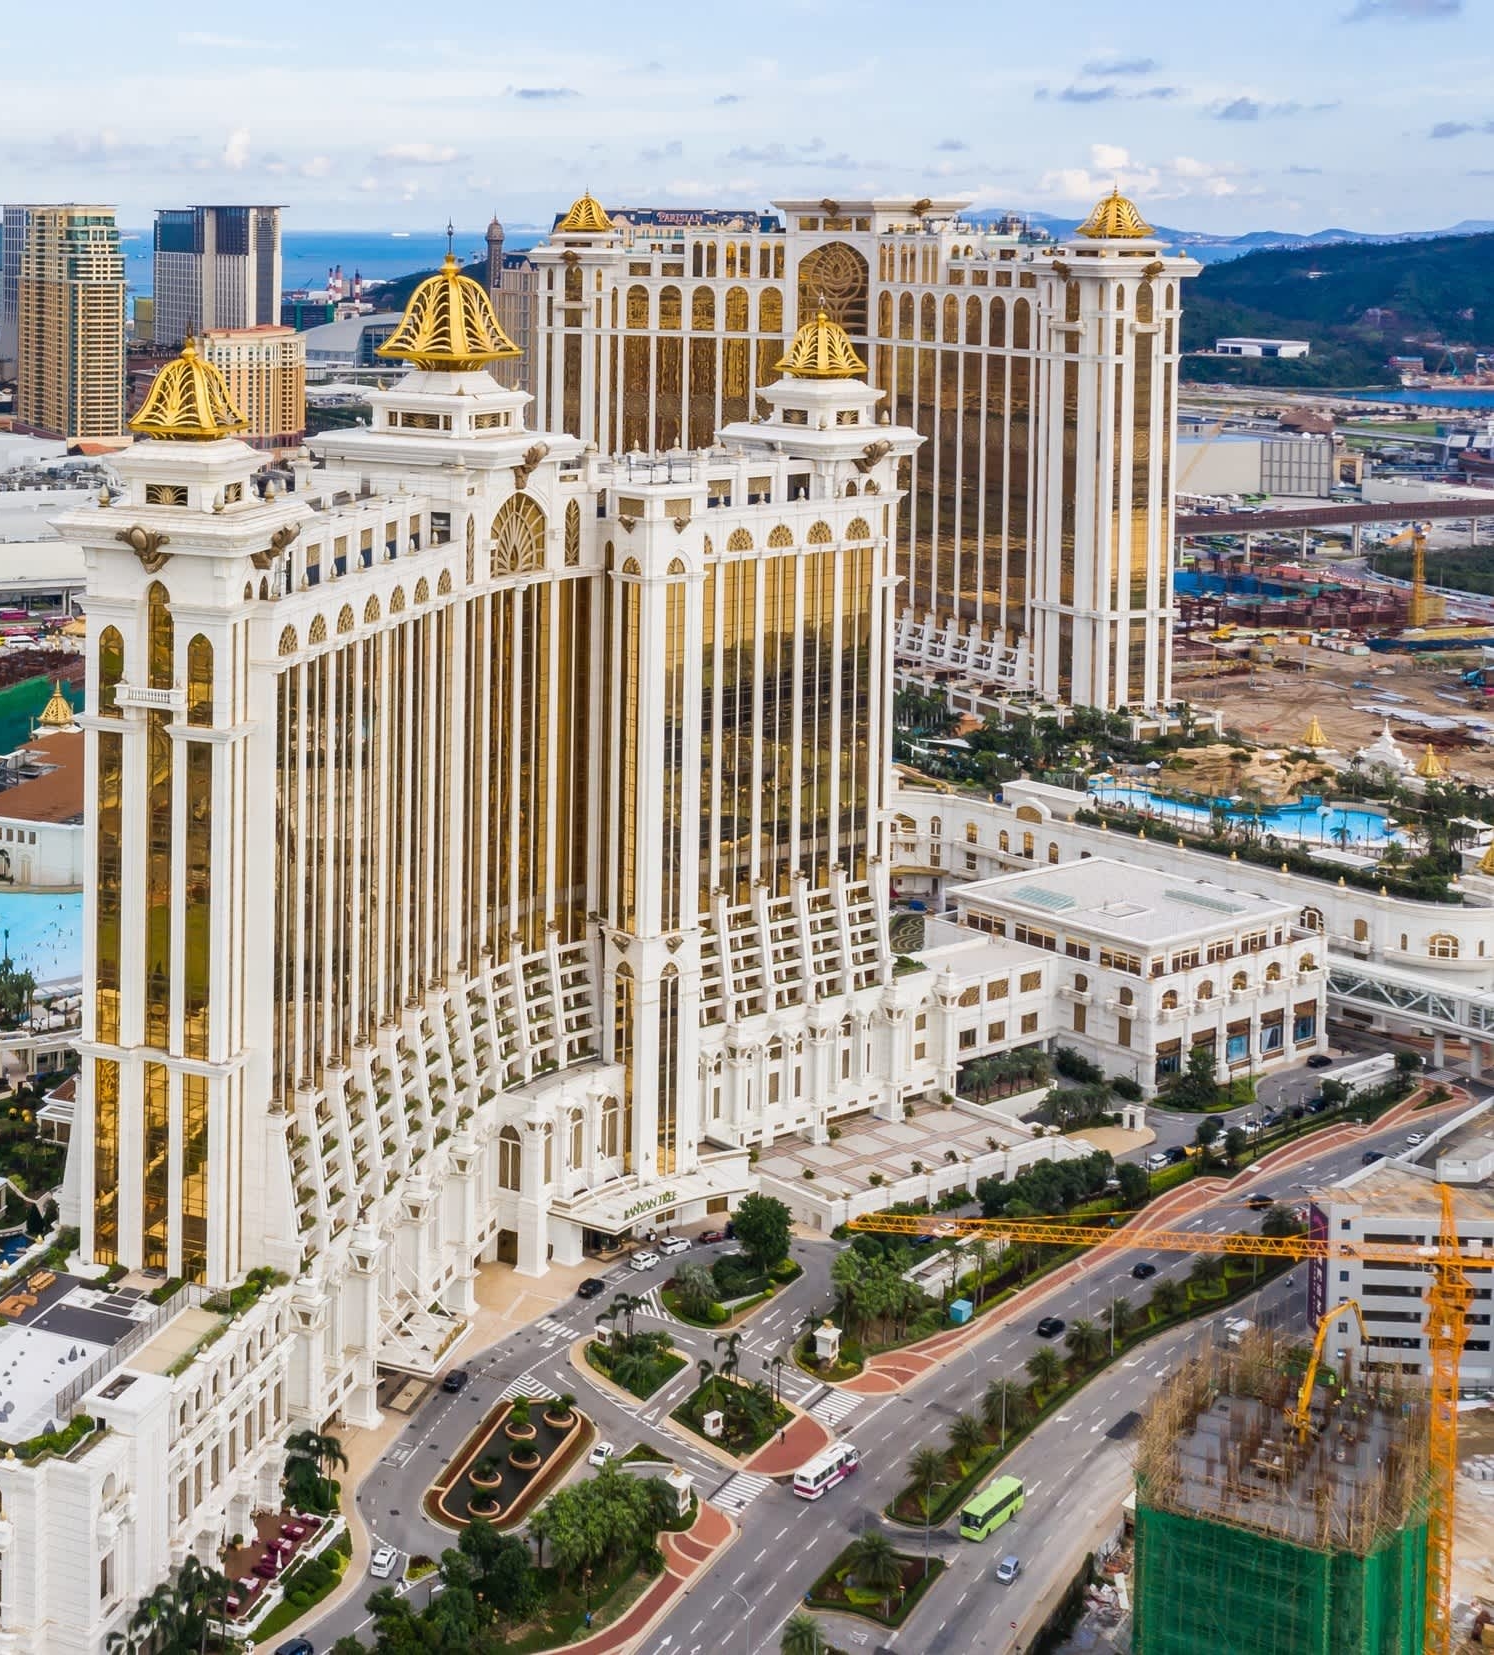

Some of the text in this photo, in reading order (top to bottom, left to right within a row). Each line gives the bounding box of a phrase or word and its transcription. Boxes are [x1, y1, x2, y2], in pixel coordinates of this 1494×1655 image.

[656, 211, 704, 225] PARISIAN
[624, 1190, 677, 1221] BANYAN TREE
